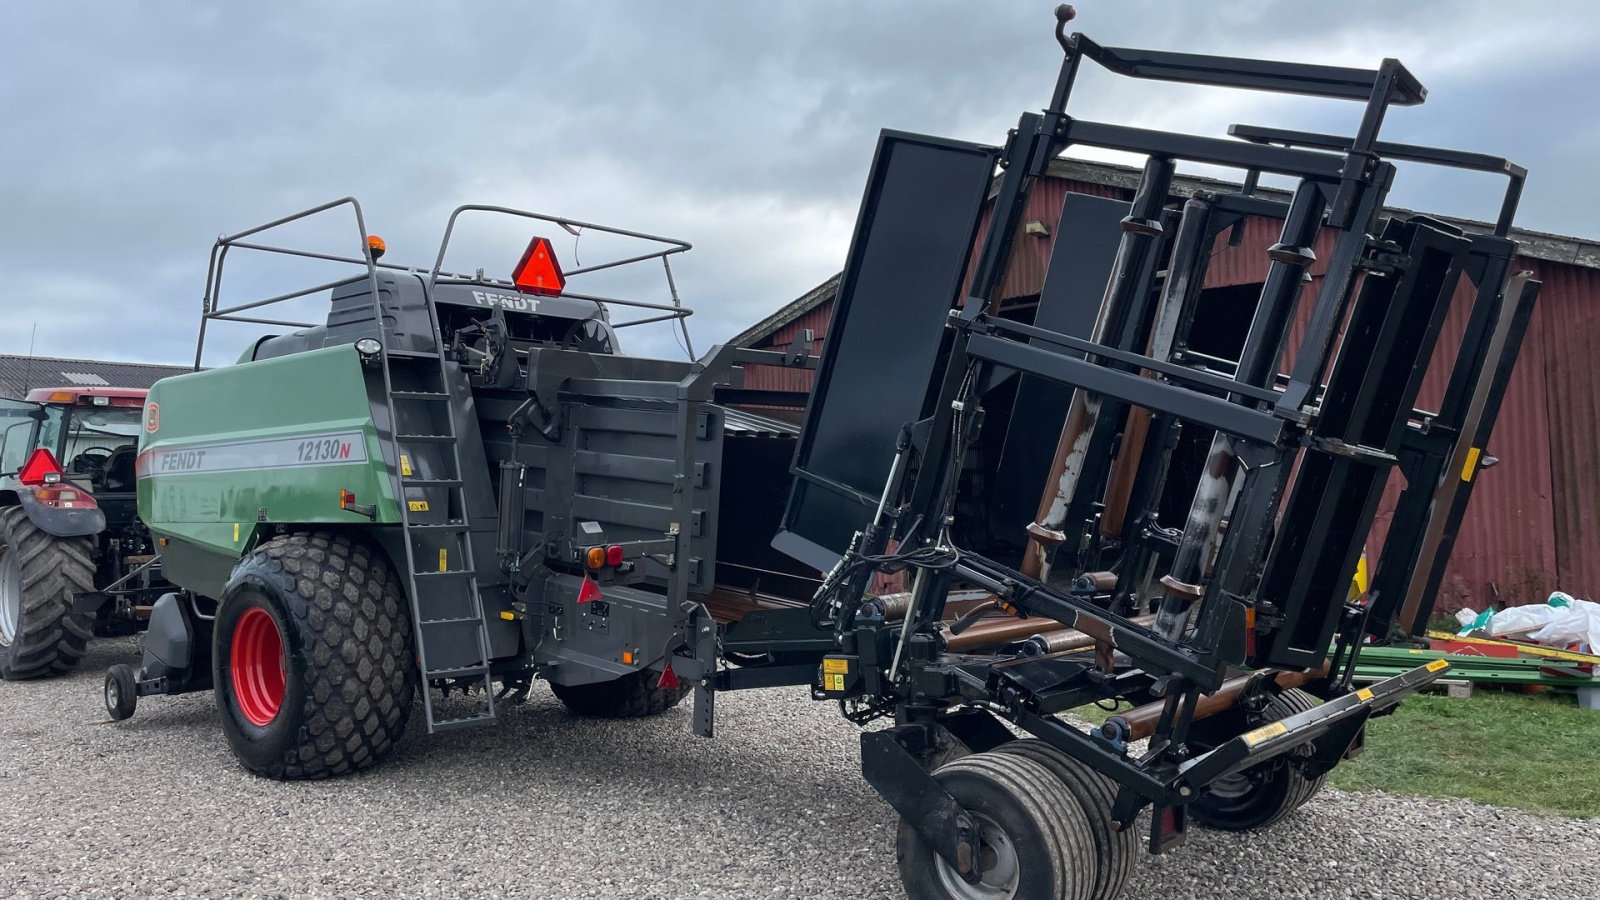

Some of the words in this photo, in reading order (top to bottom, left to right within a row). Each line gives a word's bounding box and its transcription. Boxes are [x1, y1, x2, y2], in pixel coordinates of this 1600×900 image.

[472, 290, 540, 312] FENDT
[161, 450, 206, 471] FENDT
[297, 439, 351, 461] 12130N
